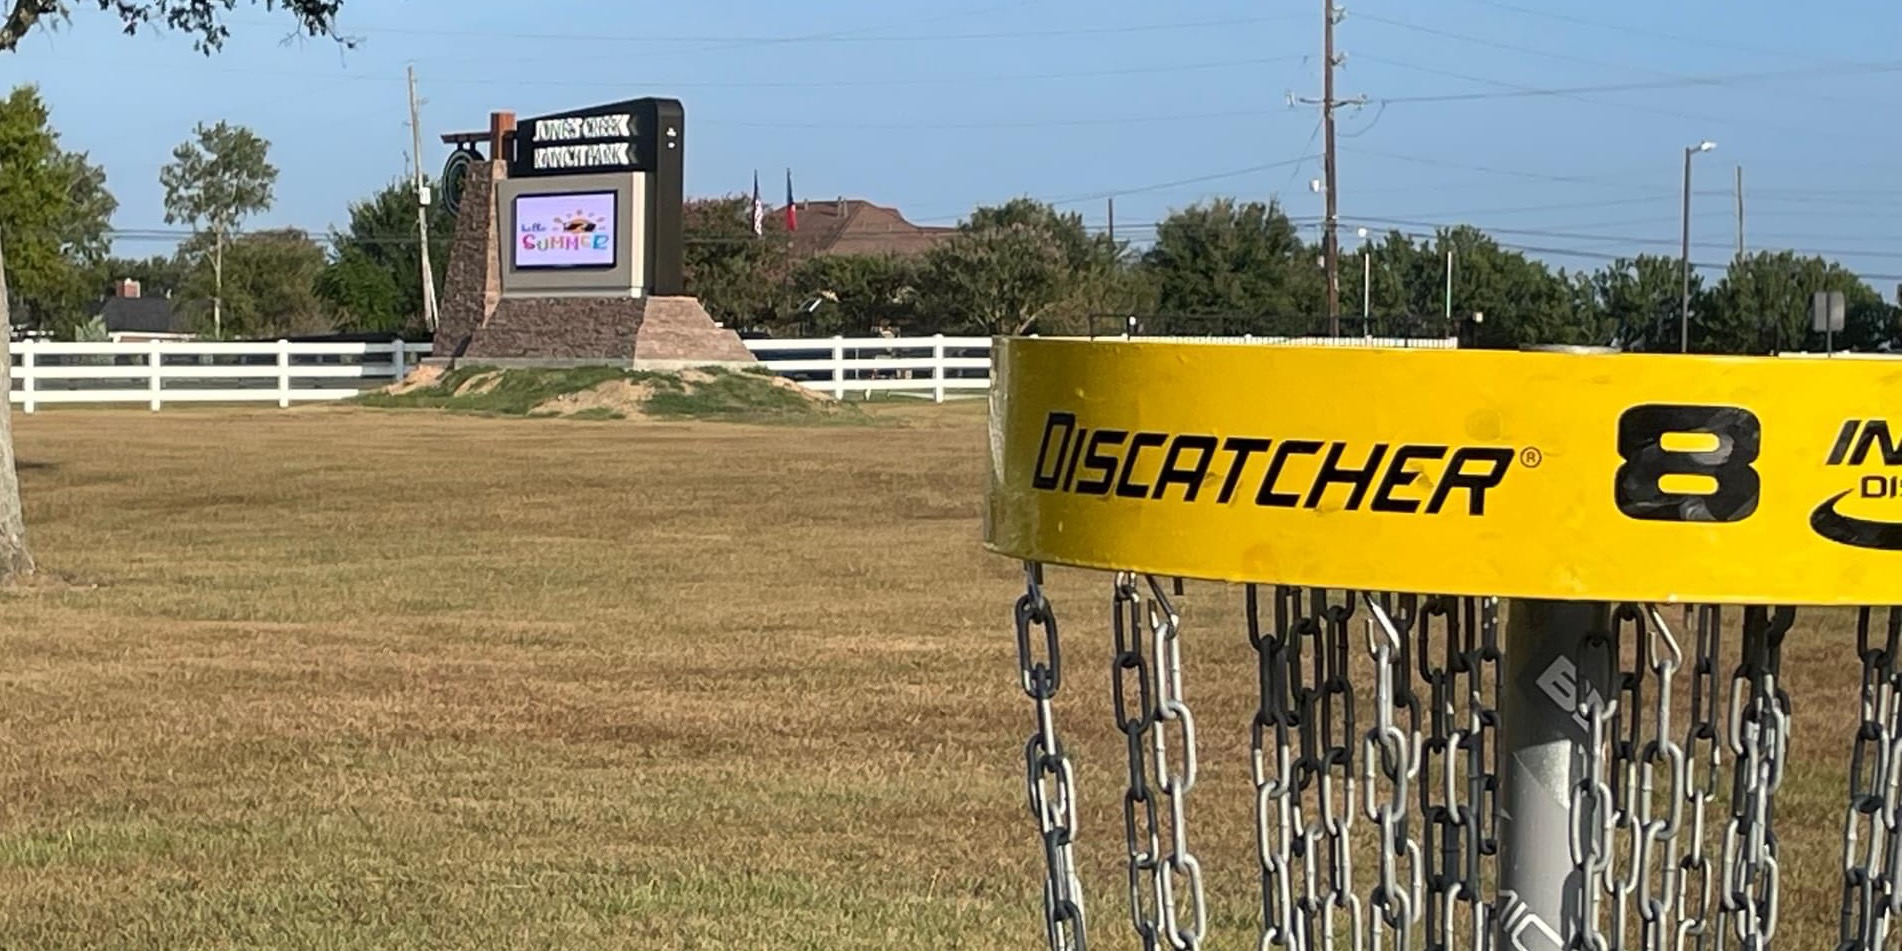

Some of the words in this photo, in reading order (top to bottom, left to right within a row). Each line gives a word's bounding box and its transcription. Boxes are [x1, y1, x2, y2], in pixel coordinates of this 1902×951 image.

[582, 114, 630, 138] CREEK
[588, 142, 630, 165] PARK
[1614, 404, 1761, 522] 8
